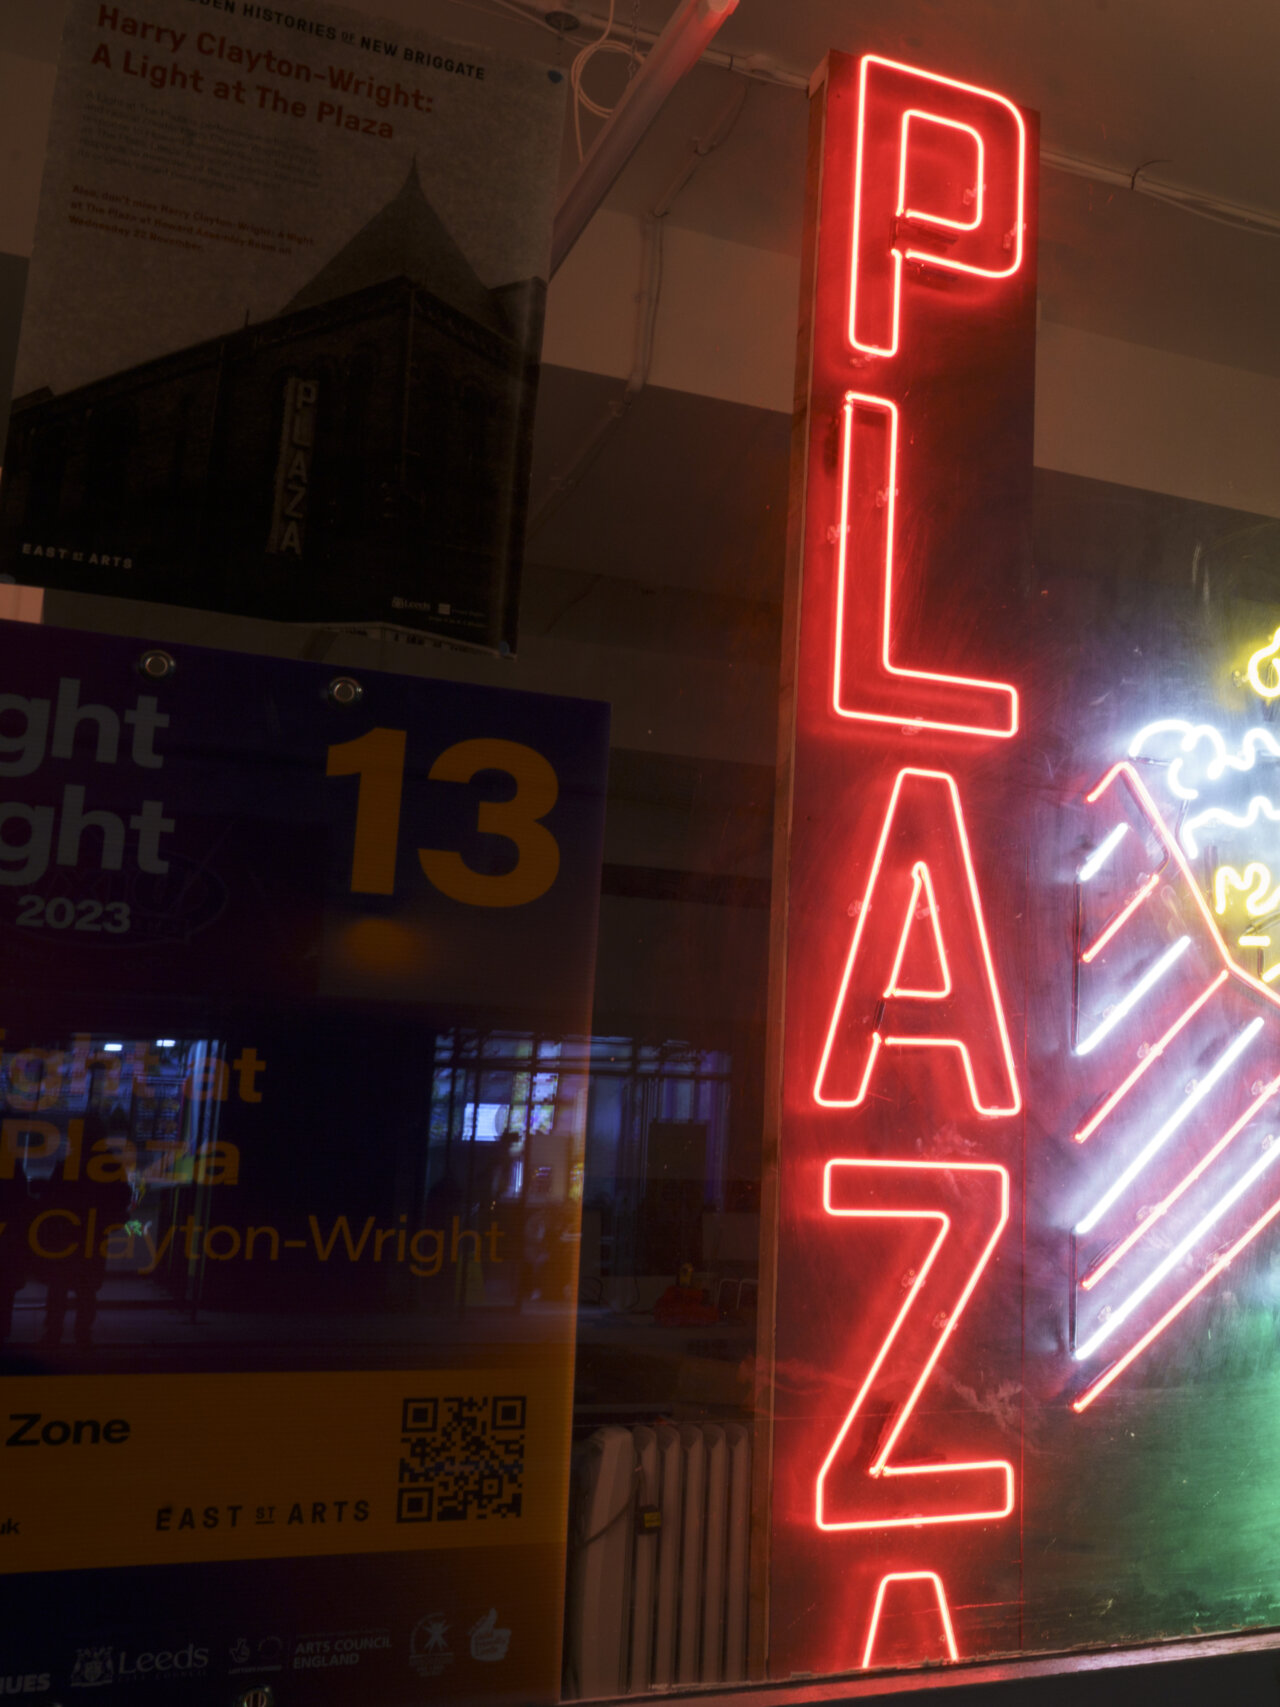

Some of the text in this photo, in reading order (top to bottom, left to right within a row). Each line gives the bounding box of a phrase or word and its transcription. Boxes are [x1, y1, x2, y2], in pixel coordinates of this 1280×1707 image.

[98, 5, 434, 113] Harry Clayton-Wright:
[243, 3, 337, 41] HISTORIES
[360, 36, 398, 57] NEW
[403, 47, 486, 81] BRIGGATE
[91, 43, 394, 140] A Light at The Plaza
[279, 379, 320, 556] PLAZA
[21, 542, 69, 561] EAST
[88, 552, 133, 569] ARTS
[326, 726, 562, 909] 13
[811, 53, 1030, 1668] PLAZ
[15, 894, 132, 935] 2023
[186, 1047, 267, 1104] at
[0, 1118, 241, 1186] Plaza
[27, 1207, 507, 1277] Clayton-Wright
[5, 1413, 131, 1447] Zone
[155, 1500, 370, 1531] EAST ST ARTS
[119, 1642, 209, 1676] Leeds
[292, 1652, 360, 1670] ENGLAND
[295, 1635, 393, 1656] ARTS COUNCIL
